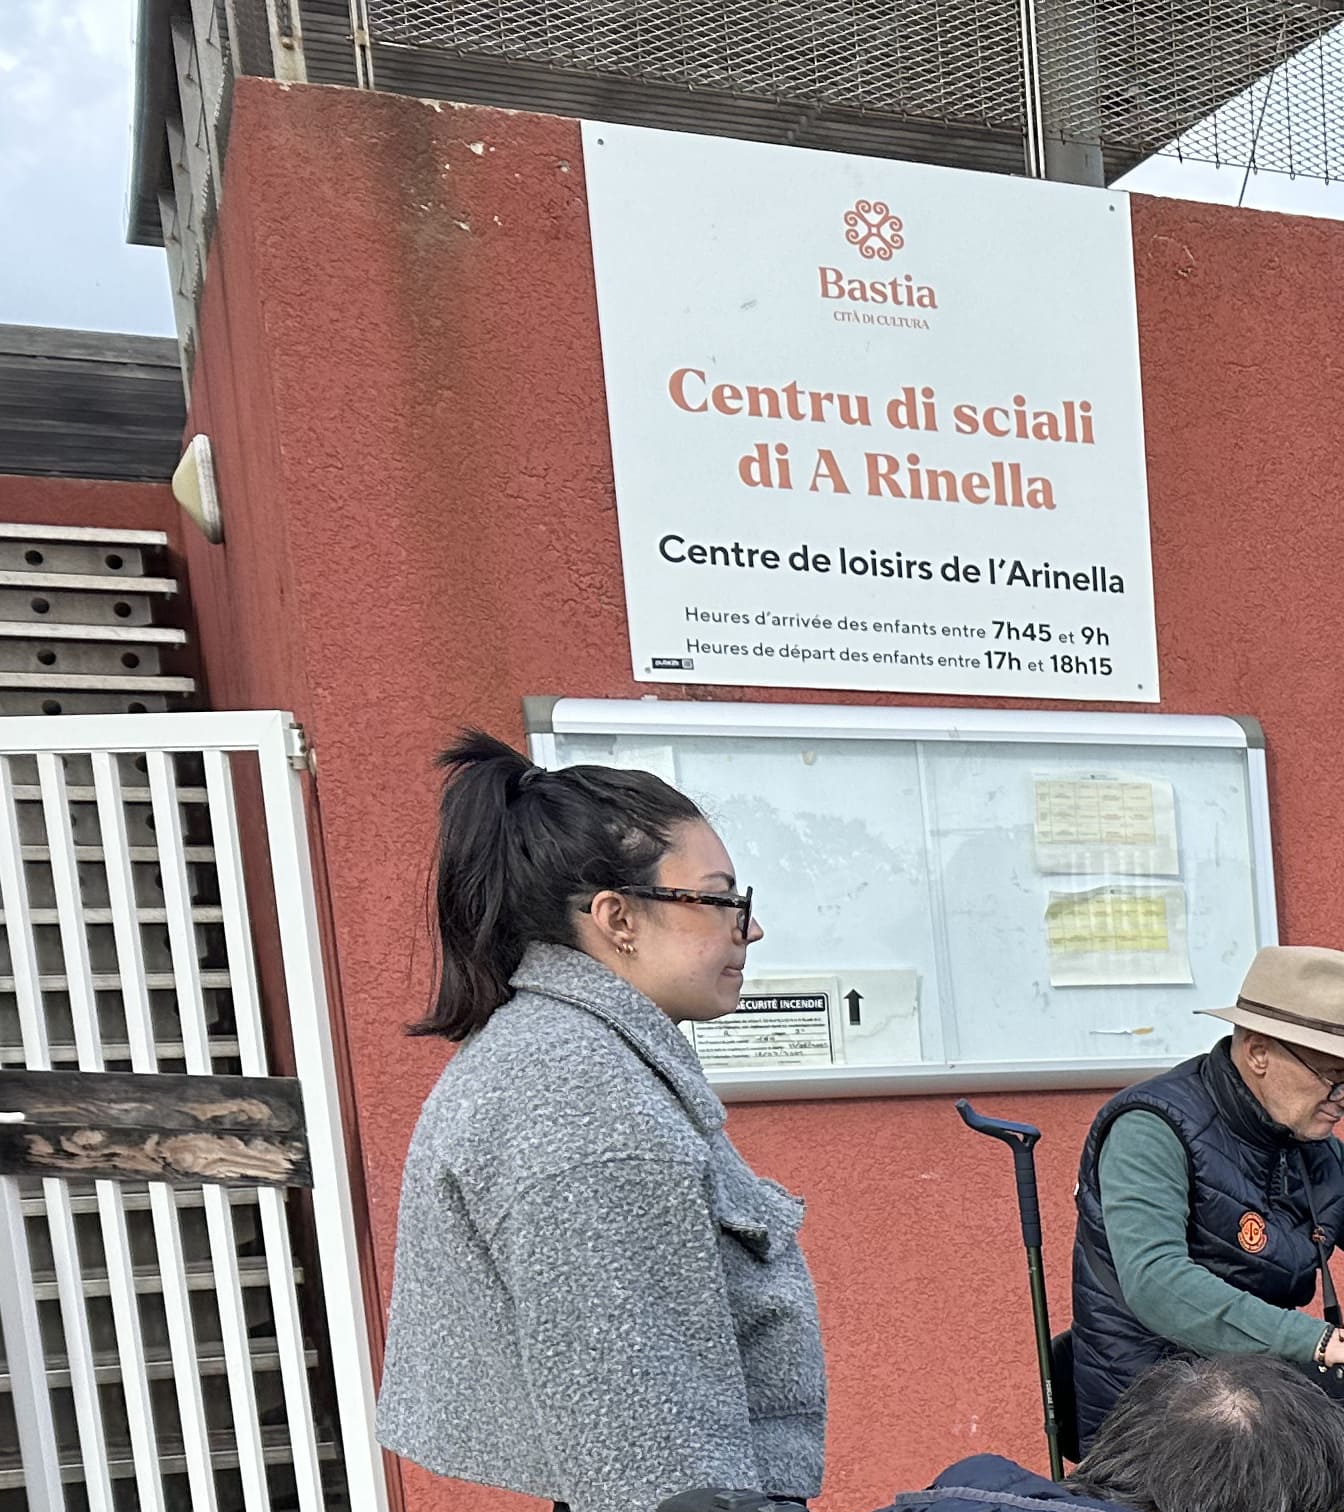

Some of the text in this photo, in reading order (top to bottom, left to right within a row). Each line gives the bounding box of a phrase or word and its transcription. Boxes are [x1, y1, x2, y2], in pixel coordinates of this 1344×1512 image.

[818, 266, 938, 309] Bastia
[833, 310, 930, 330] CITÀ DI CULTURA
[668, 367, 1096, 445] Centru di sciali
[738, 443, 1057, 511] di A Rinella
[658, 534, 1126, 594] Centre de loisirs de l'Arinella
[685, 606, 1111, 647] Heures d'arrivée des enfants entre 7h45 et 9h
[686, 638, 1114, 677] Heures de départ des enfants entre 17h et 18h15
[779, 998, 824, 1010] INCENDIE
